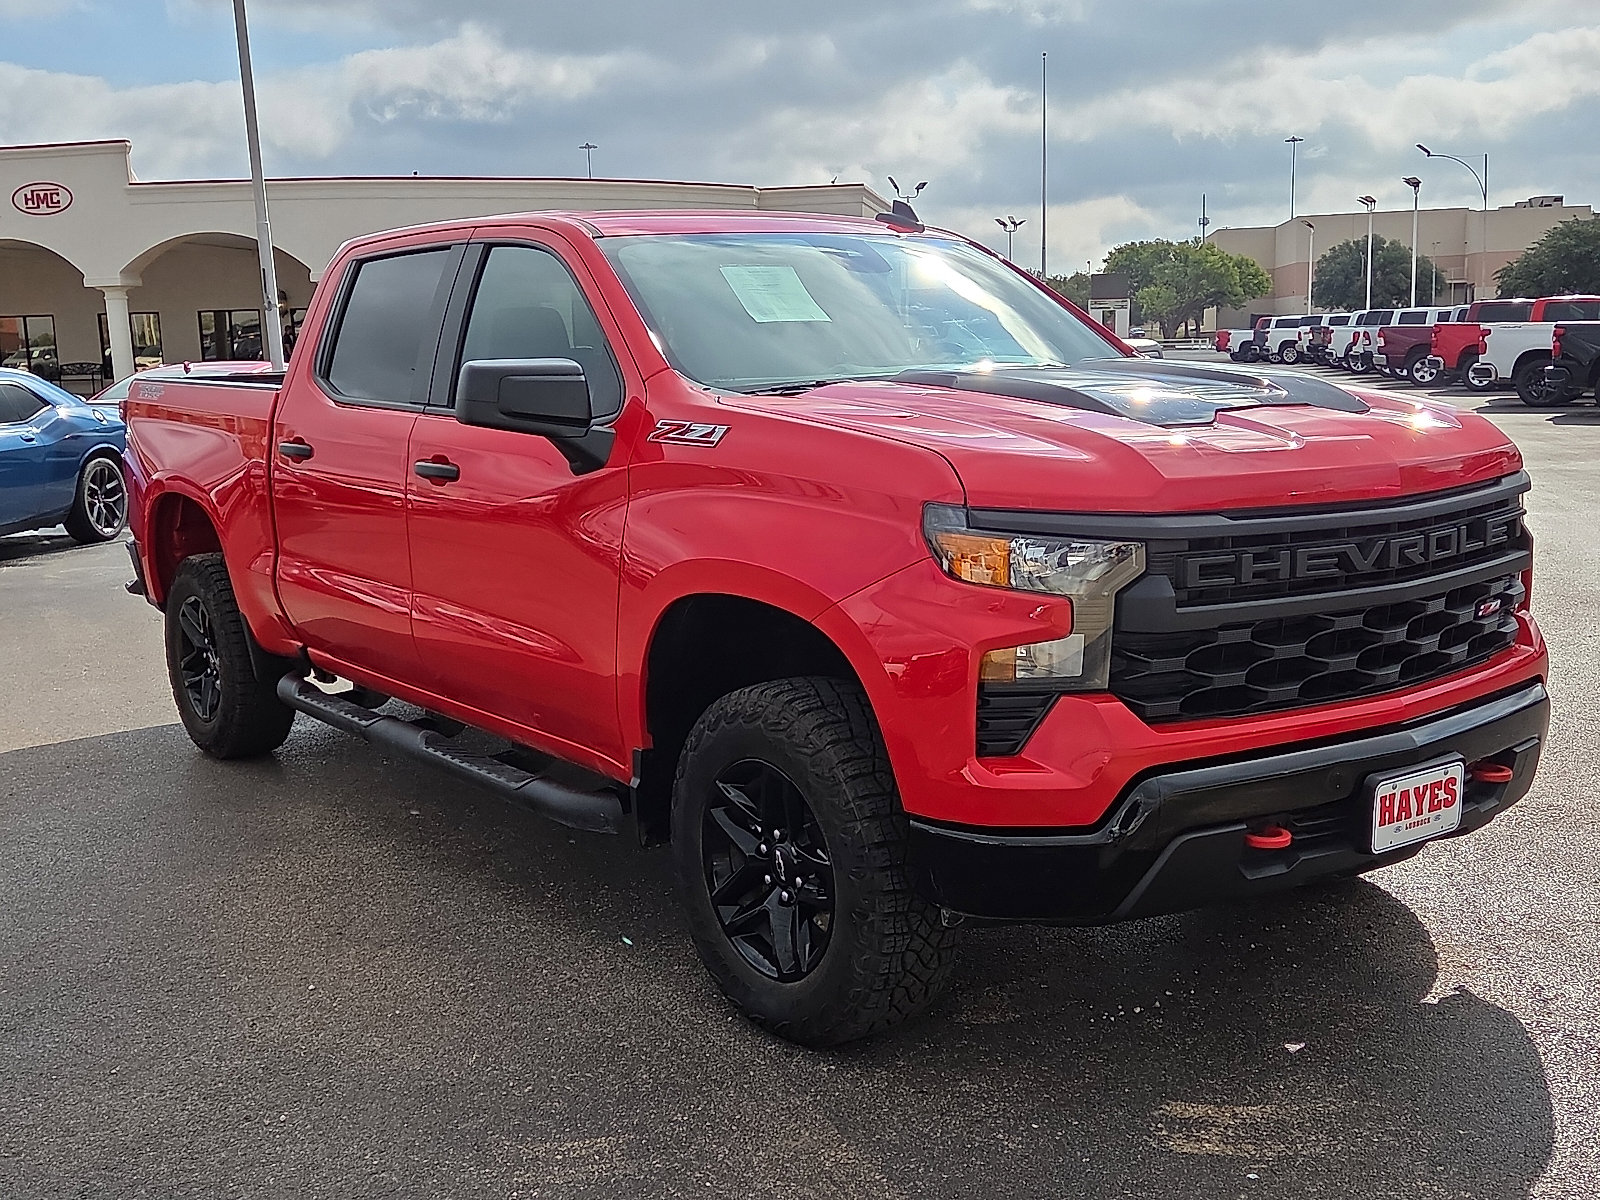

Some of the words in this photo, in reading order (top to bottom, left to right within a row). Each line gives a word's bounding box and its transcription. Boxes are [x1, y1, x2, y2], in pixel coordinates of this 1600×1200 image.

[24, 188, 61, 209] HMC
[647, 419, 732, 447] Z71
[1186, 518, 1527, 588] CHEVROLET
[1378, 777, 1458, 828] HAYES
